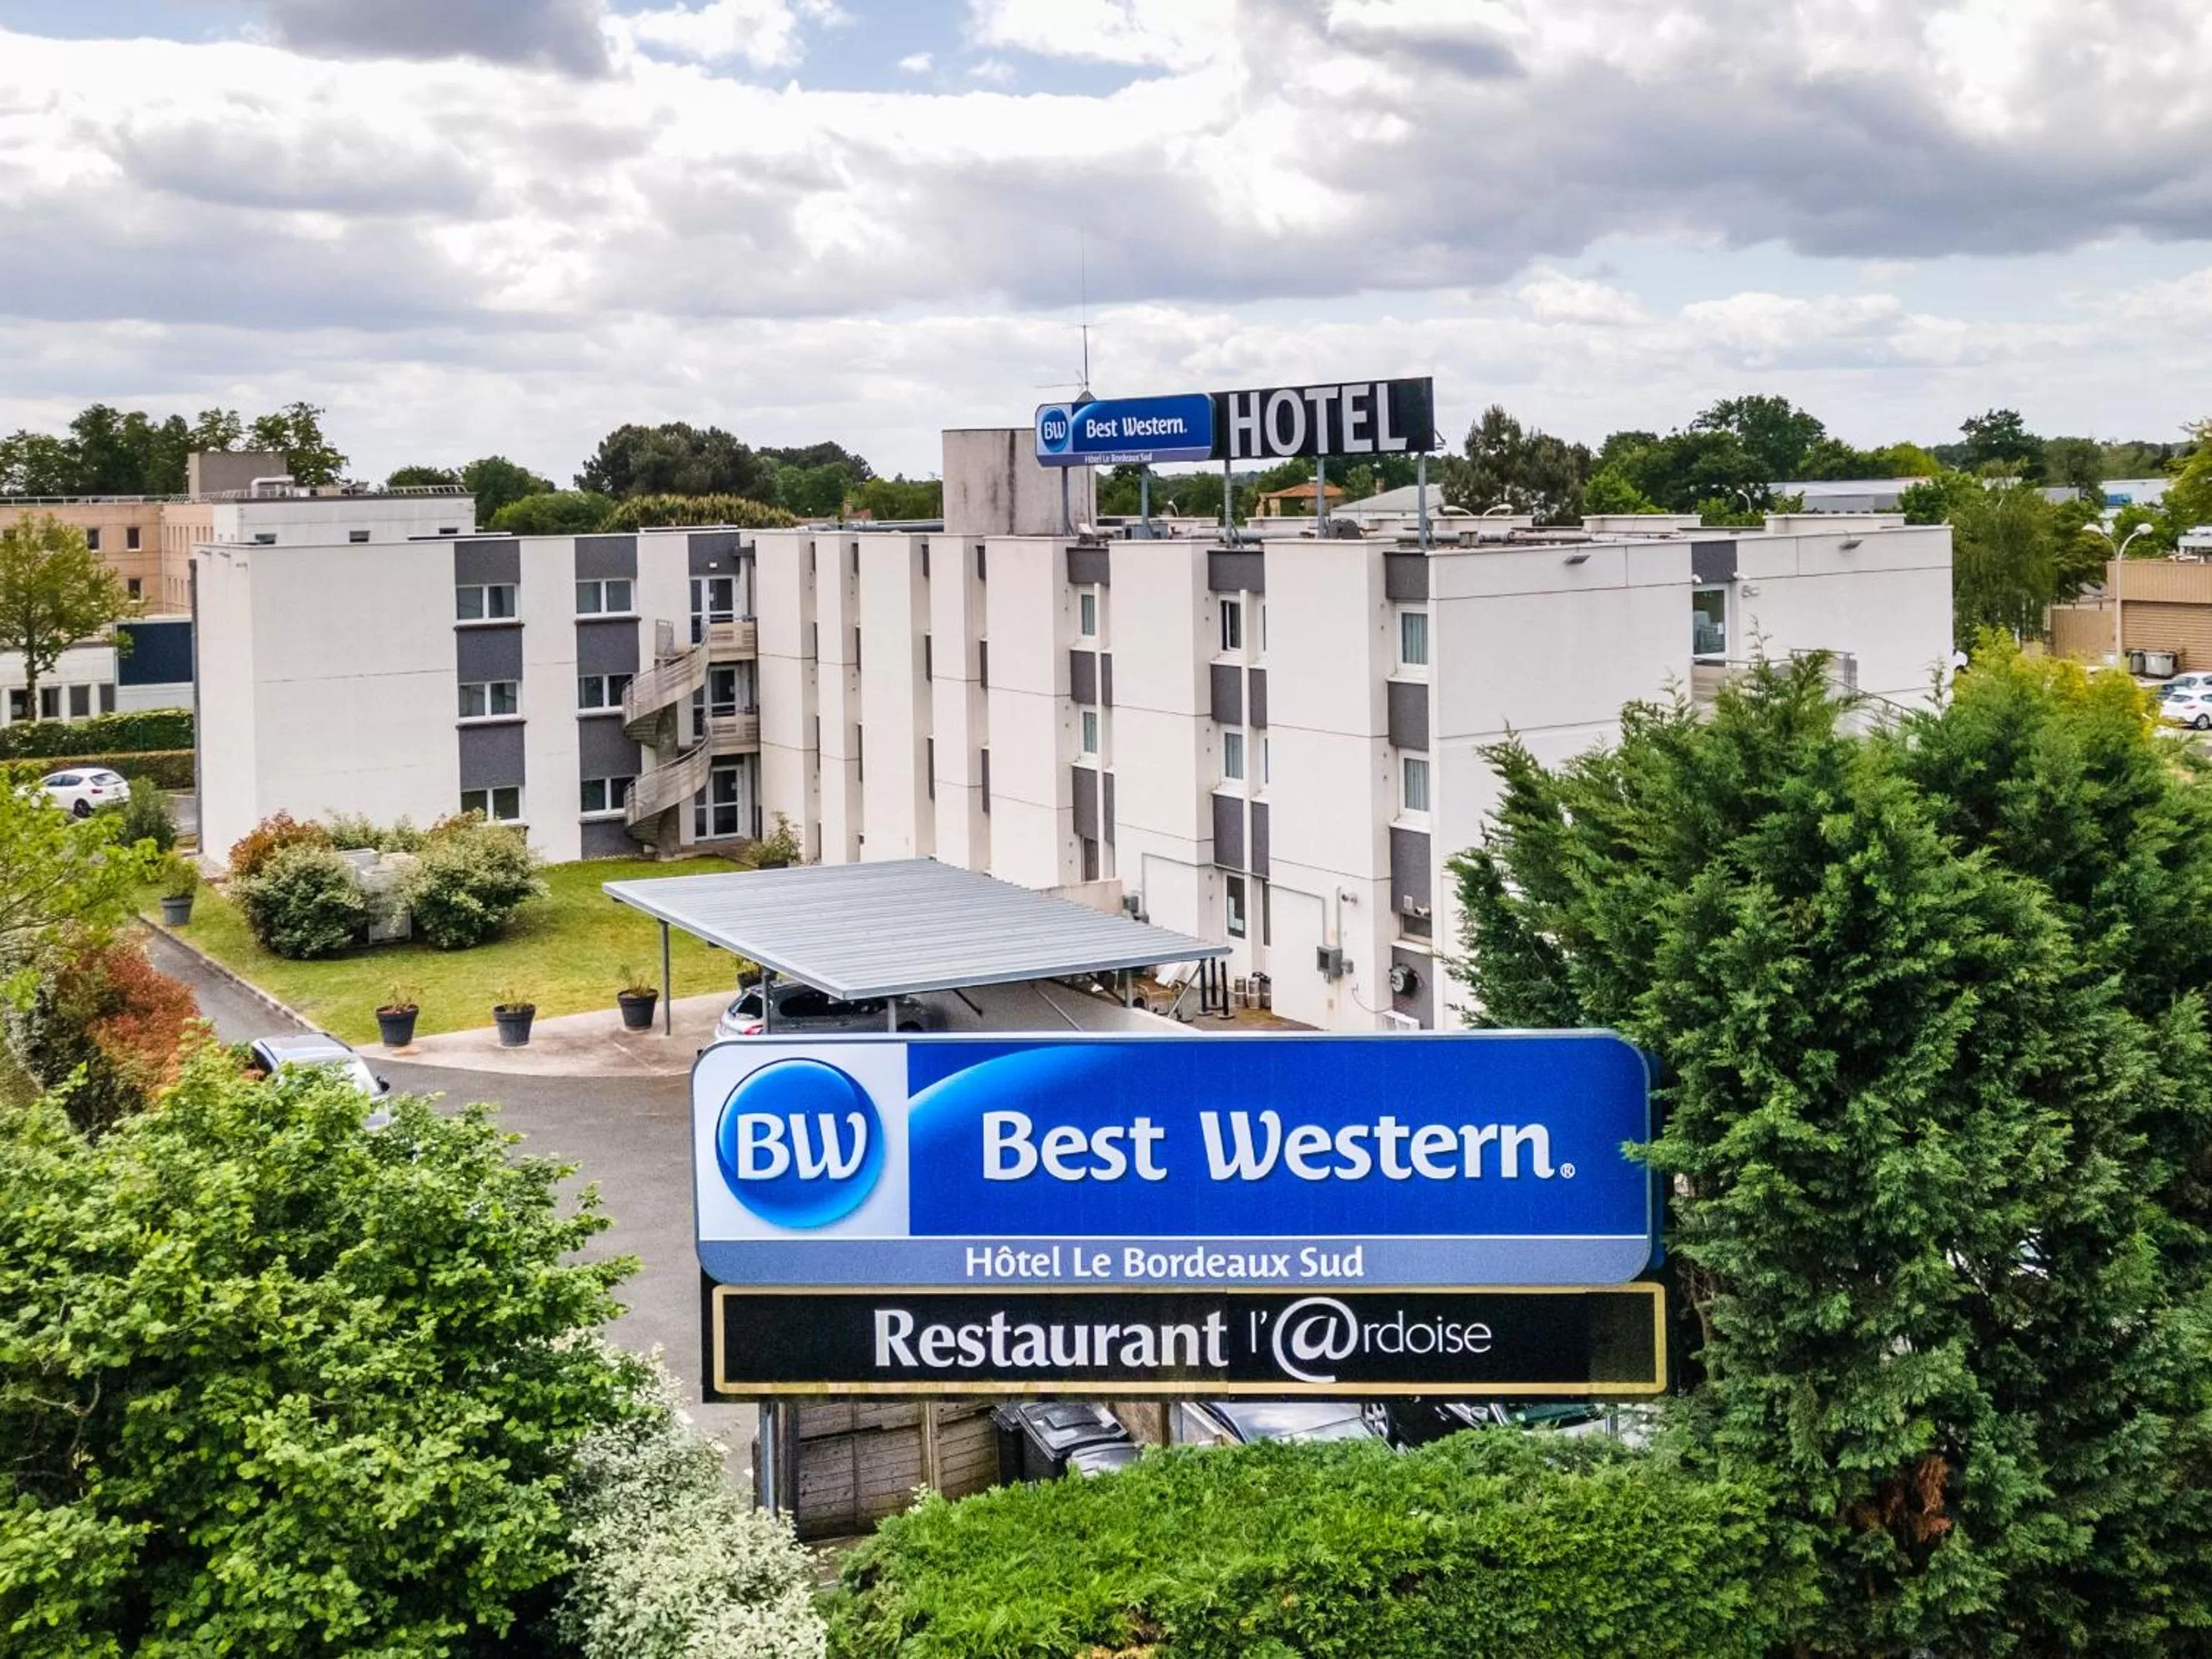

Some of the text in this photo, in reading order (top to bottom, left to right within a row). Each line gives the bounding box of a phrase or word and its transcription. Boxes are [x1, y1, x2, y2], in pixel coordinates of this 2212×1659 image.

[1044, 421, 1066, 440] BW
[1086, 419, 1117, 439] Best
[1228, 383, 1407, 458] HOTEL
[737, 1112, 867, 1180] BW
[982, 1110, 1167, 1180] Best
[965, 1246, 1365, 1278] Hôtel Le Bordeaux Sud
[874, 1310, 1229, 1368] Restaurant
